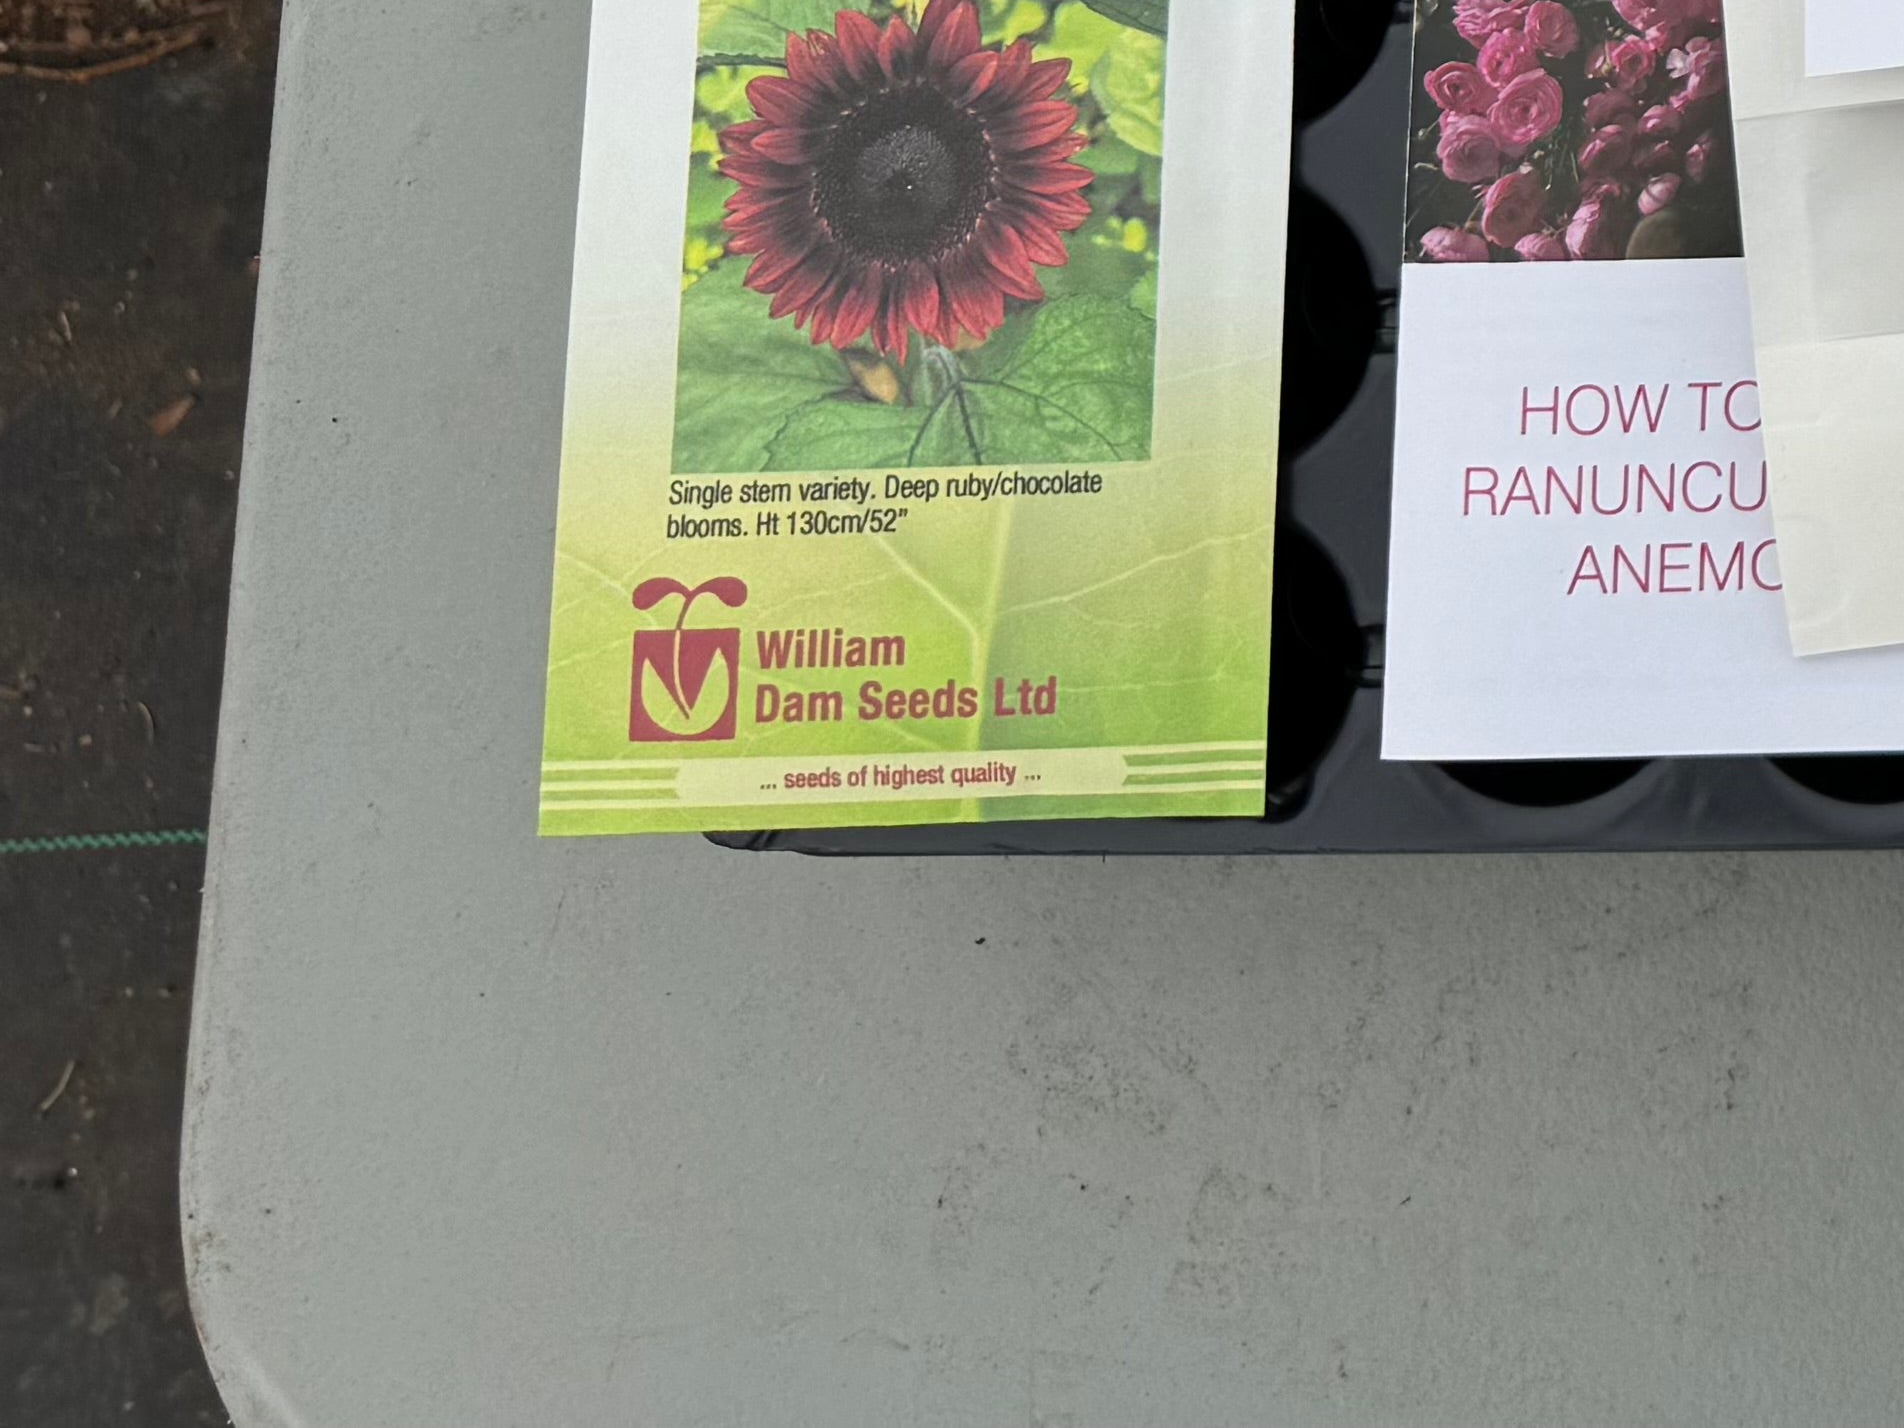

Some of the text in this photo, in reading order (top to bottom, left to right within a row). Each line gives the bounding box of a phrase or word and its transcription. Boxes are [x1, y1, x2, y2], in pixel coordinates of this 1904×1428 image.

[1519, 379, 1763, 436] HOW TO
[668, 469, 1104, 510] Single stem variety. Deep ruby/chocolate
[1462, 459, 1769, 517] RANUNCU
[666, 510, 749, 539] blooms.
[756, 510, 780, 537] Ht
[756, 627, 906, 670] William
[755, 674, 1058, 724] Dam Seeds Ltd
[784, 761, 1017, 790] seeds of highest quality
